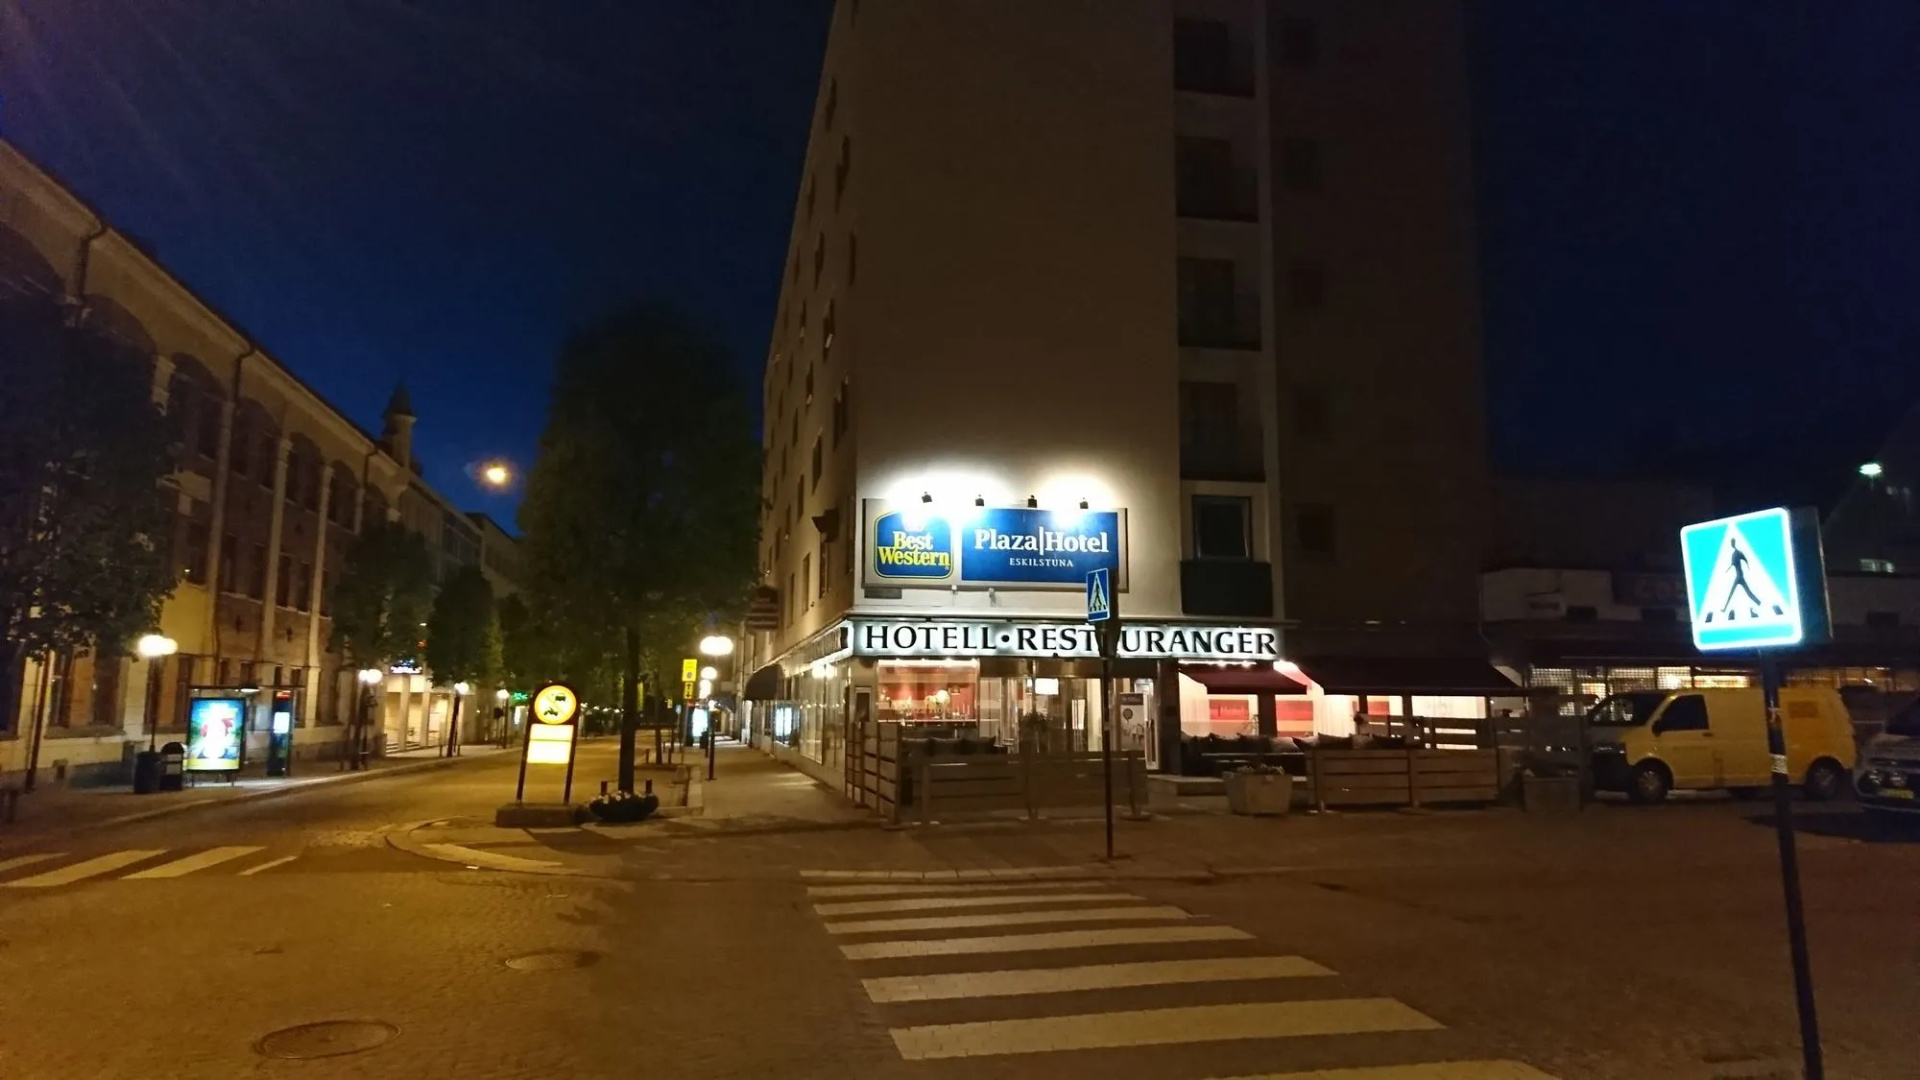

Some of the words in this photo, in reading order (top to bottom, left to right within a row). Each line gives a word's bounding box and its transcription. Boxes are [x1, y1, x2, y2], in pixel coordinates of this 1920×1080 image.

[893, 530, 933, 550] Best
[878, 546, 950, 566] Western
[1009, 557, 1074, 568] ESKILSTUNA
[866, 625, 997, 650] HOTELL
[1016, 627, 1277, 655] RESTURANGER
